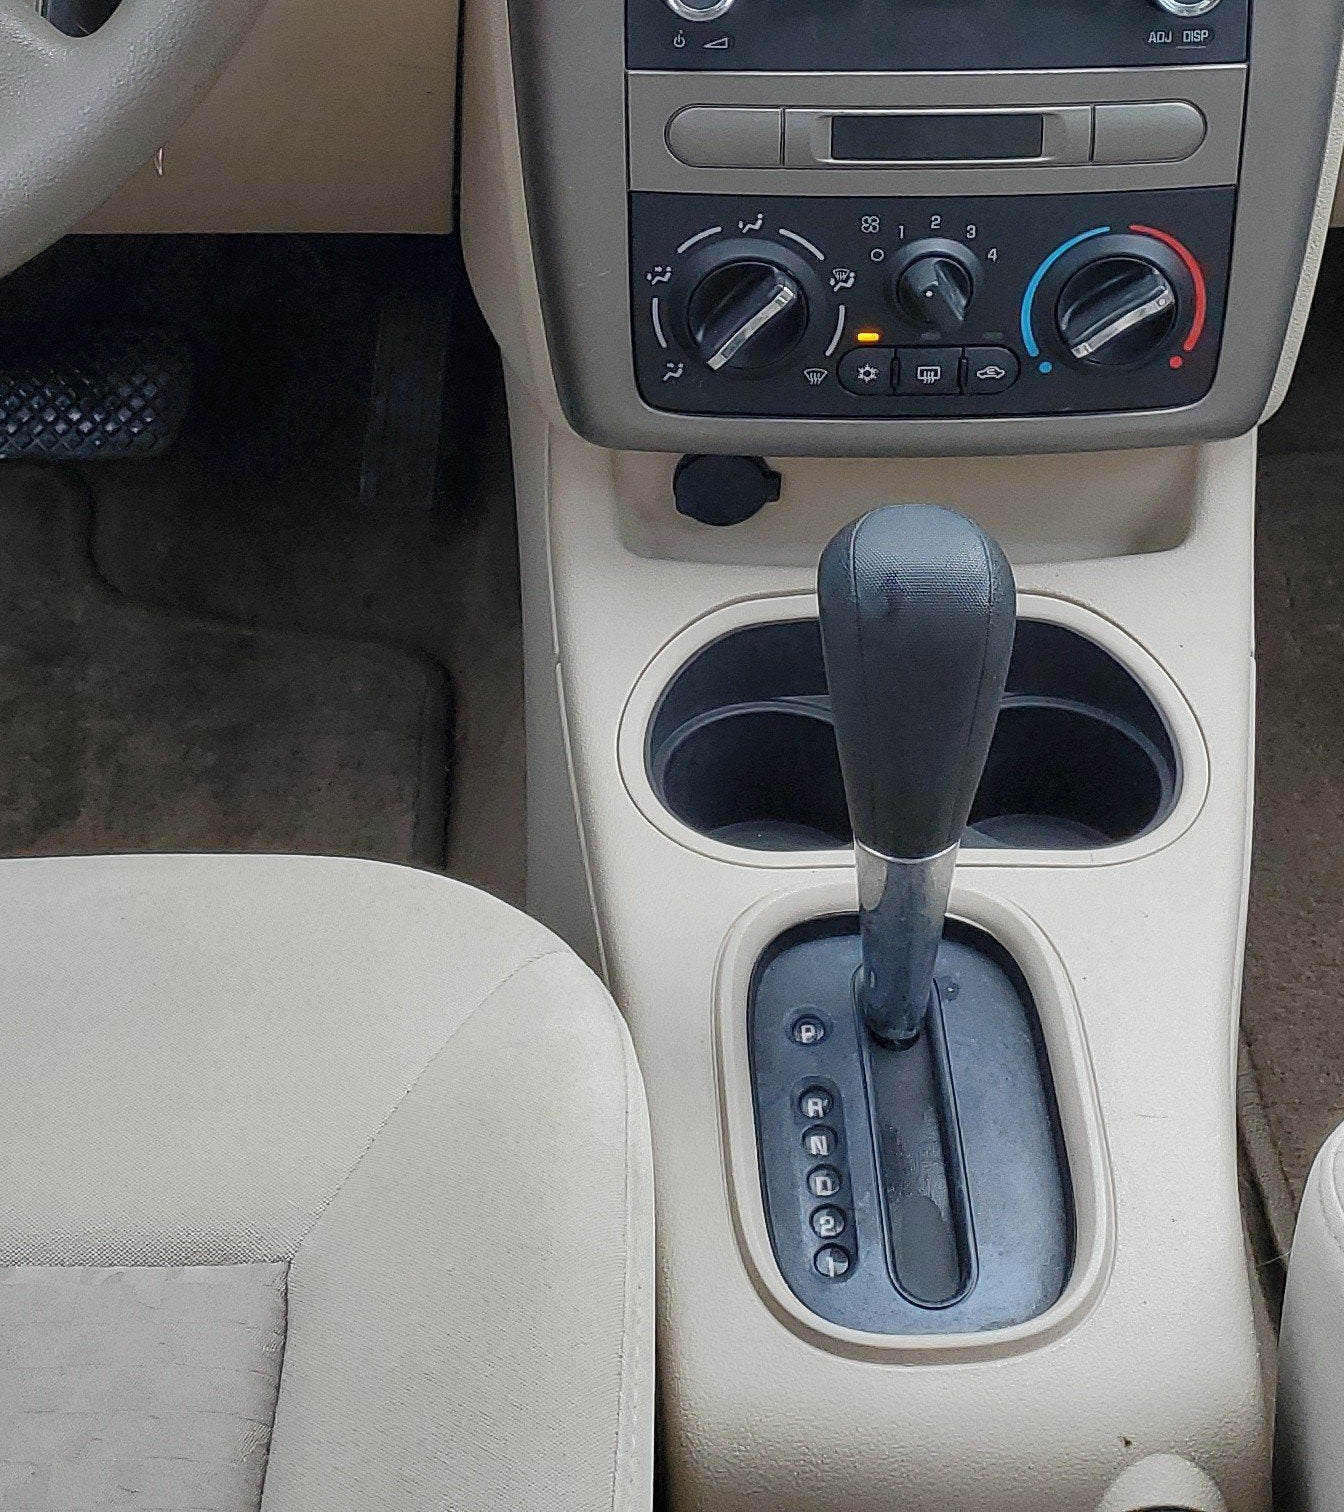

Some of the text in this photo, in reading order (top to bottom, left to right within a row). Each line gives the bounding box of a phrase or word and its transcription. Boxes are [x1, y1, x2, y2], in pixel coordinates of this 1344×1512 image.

[1147, 30, 1209, 44] ADJ DISP
[930, 216, 941, 229] 2
[898, 226, 905, 239] 1
[966, 225, 976, 239] 3
[988, 248, 998, 262] 4
[801, 1024, 818, 1044] P
[807, 1098, 824, 1118] R
[810, 1135, 828, 1155] N
[815, 1175, 833, 1196] D
[819, 1215, 835, 1236] 2
